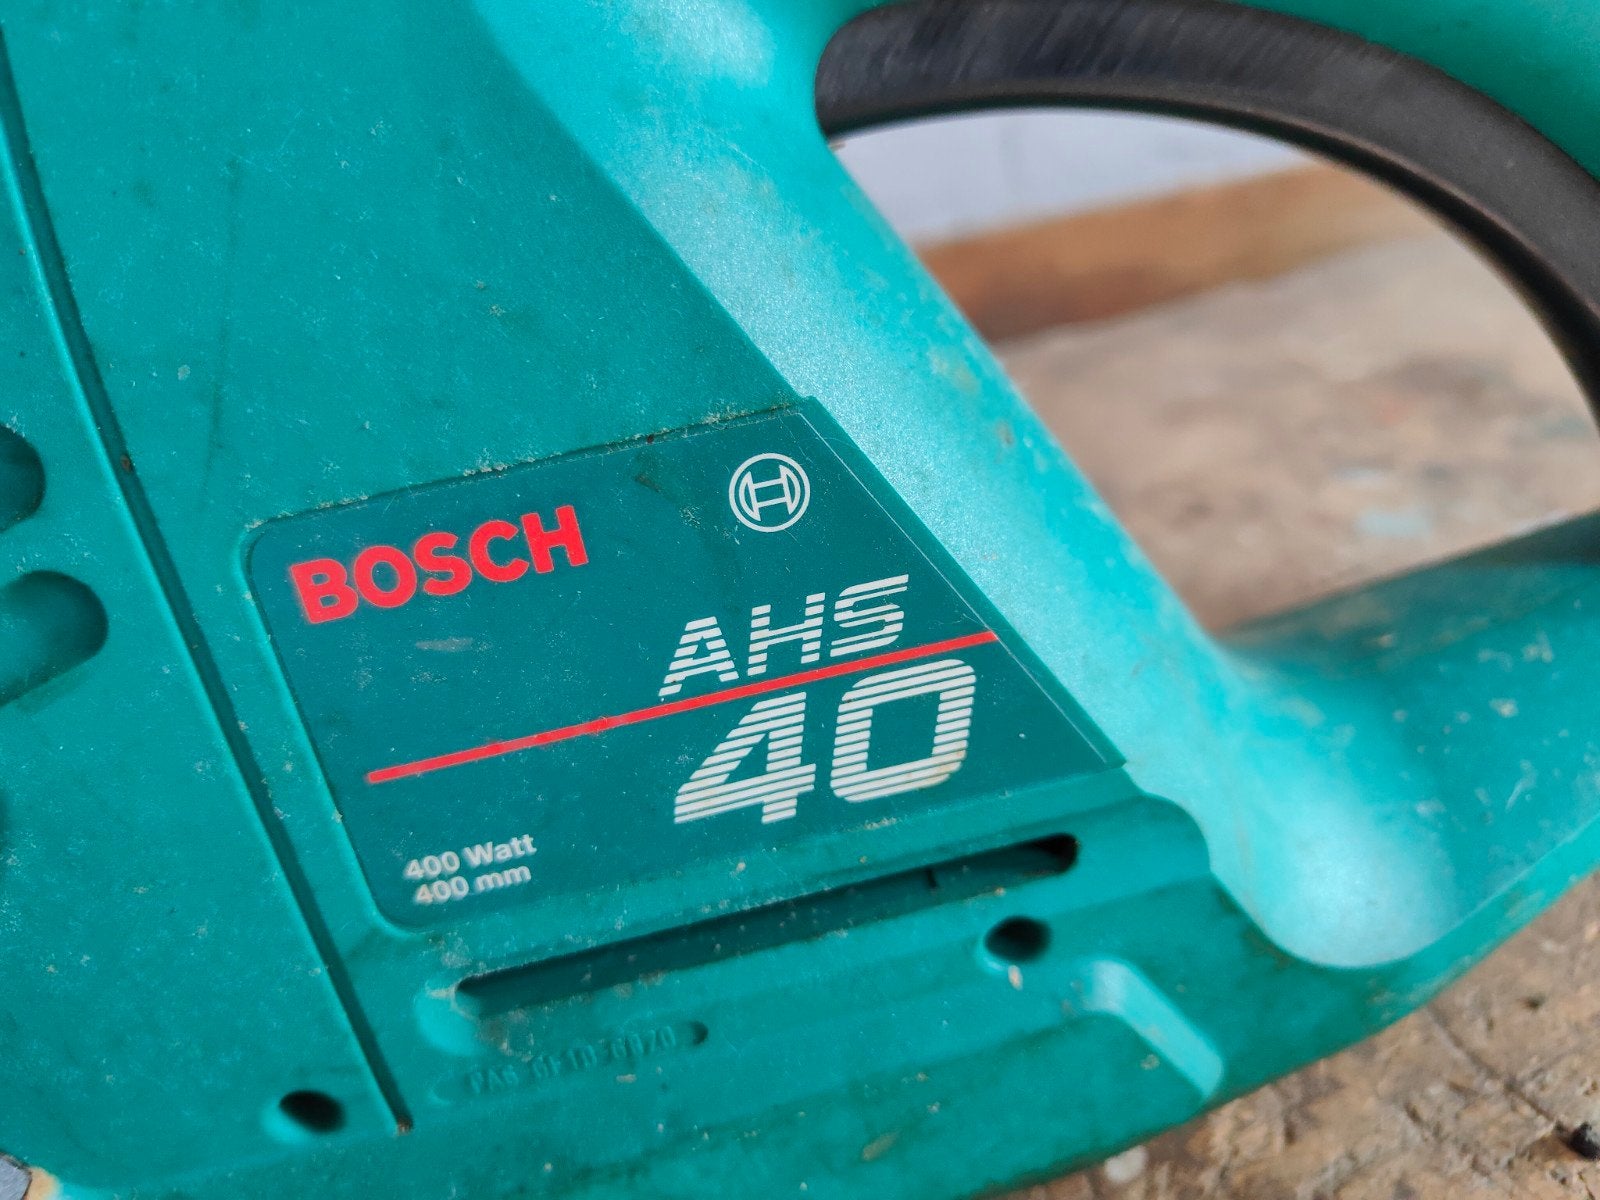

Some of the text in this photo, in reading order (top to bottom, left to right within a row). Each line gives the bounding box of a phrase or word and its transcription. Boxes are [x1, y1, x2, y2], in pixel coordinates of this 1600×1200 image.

[289, 505, 589, 624] BOSCH
[658, 574, 909, 697] AHS
[674, 659, 977, 824] 40
[404, 834, 537, 879] 400 Watt
[414, 866, 532, 904] 400 mm
